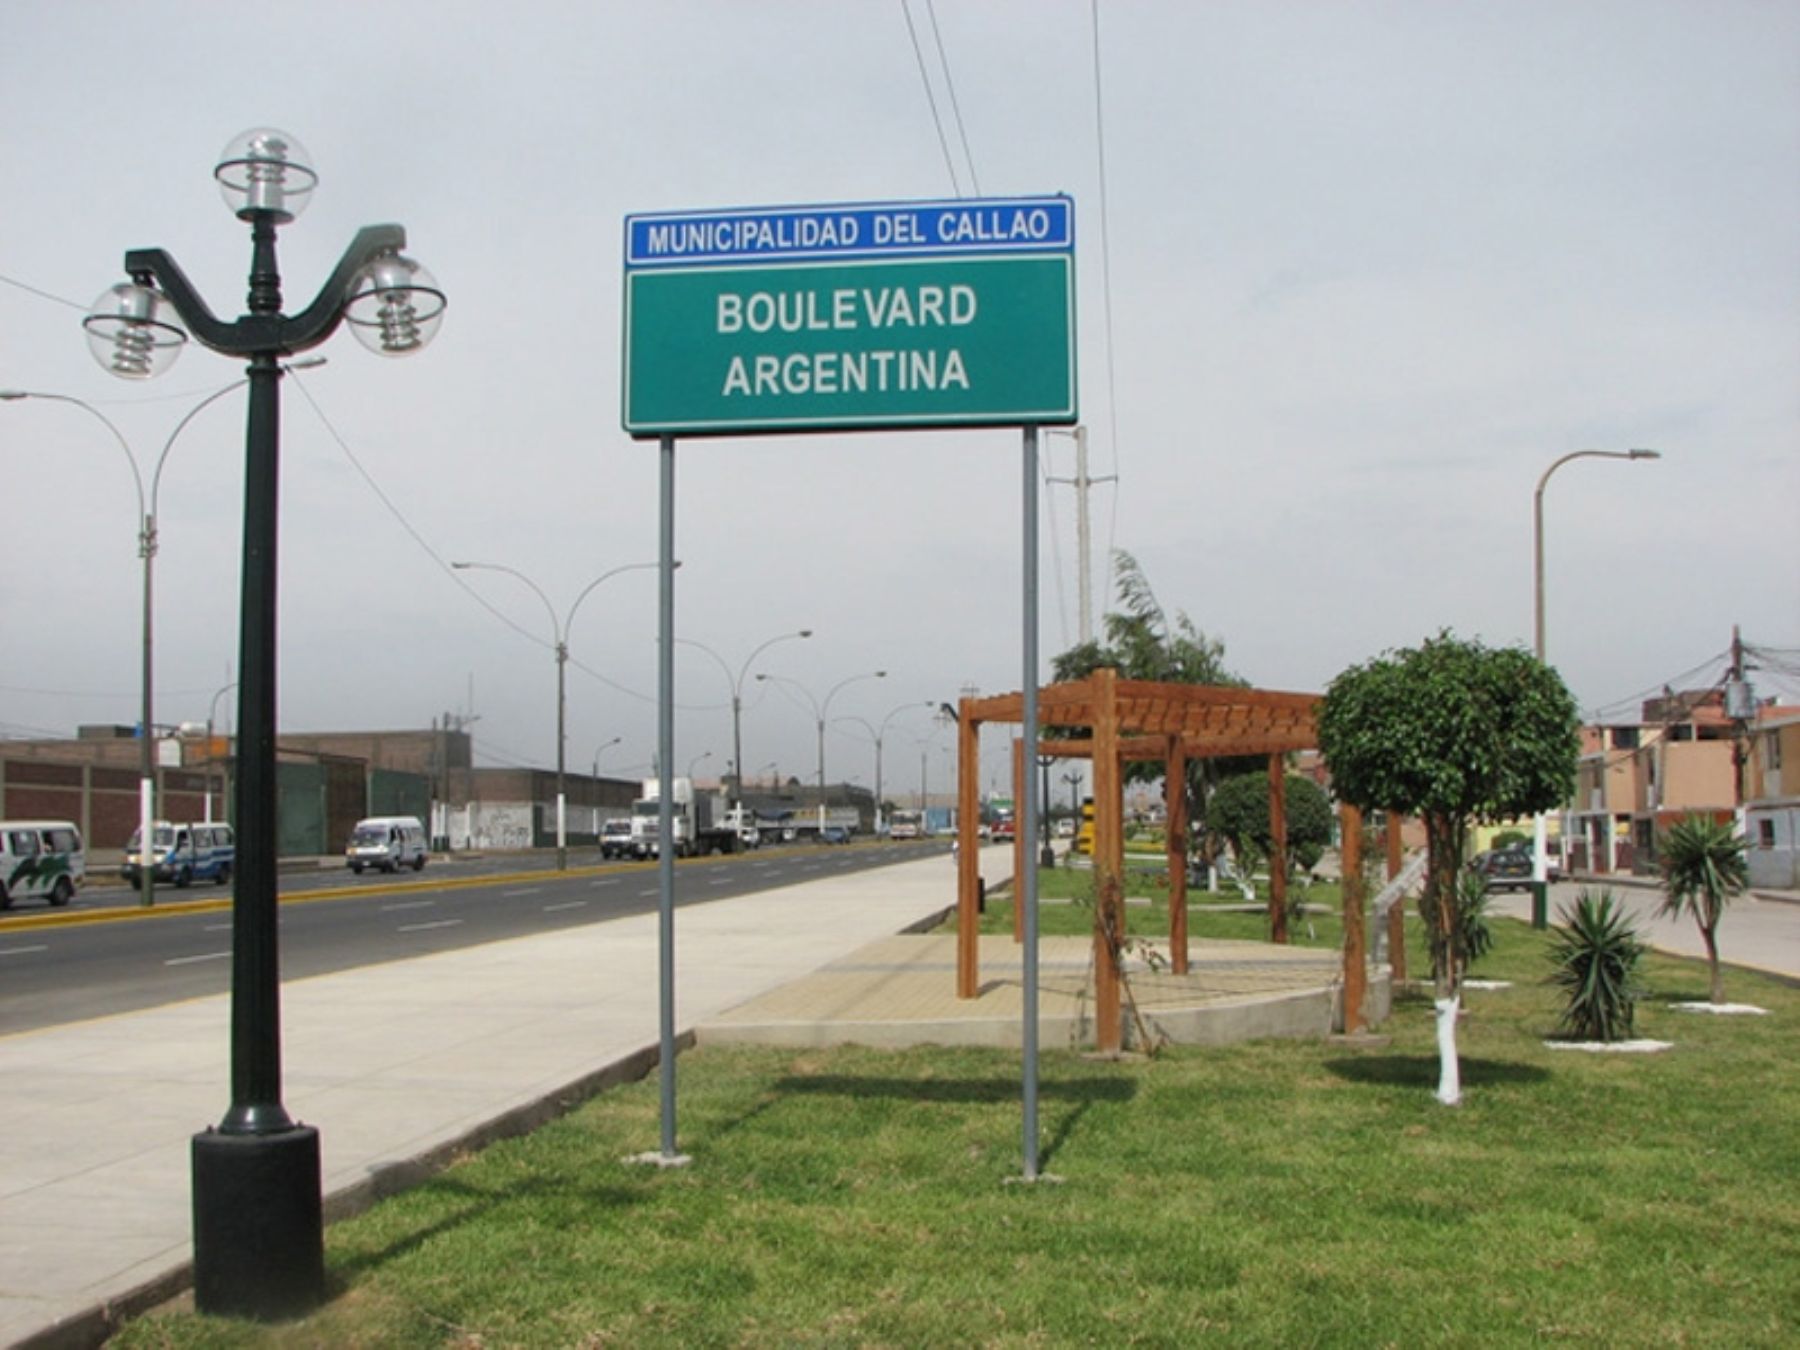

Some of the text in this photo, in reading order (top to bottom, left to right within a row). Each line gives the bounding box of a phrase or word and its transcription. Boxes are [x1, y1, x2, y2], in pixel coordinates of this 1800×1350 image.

[648, 209, 1050, 255] MUNICIPALIDAD DEL CALLAO
[716, 285, 977, 333] BOULEVARD
[721, 350, 970, 397] ARGENTINA
